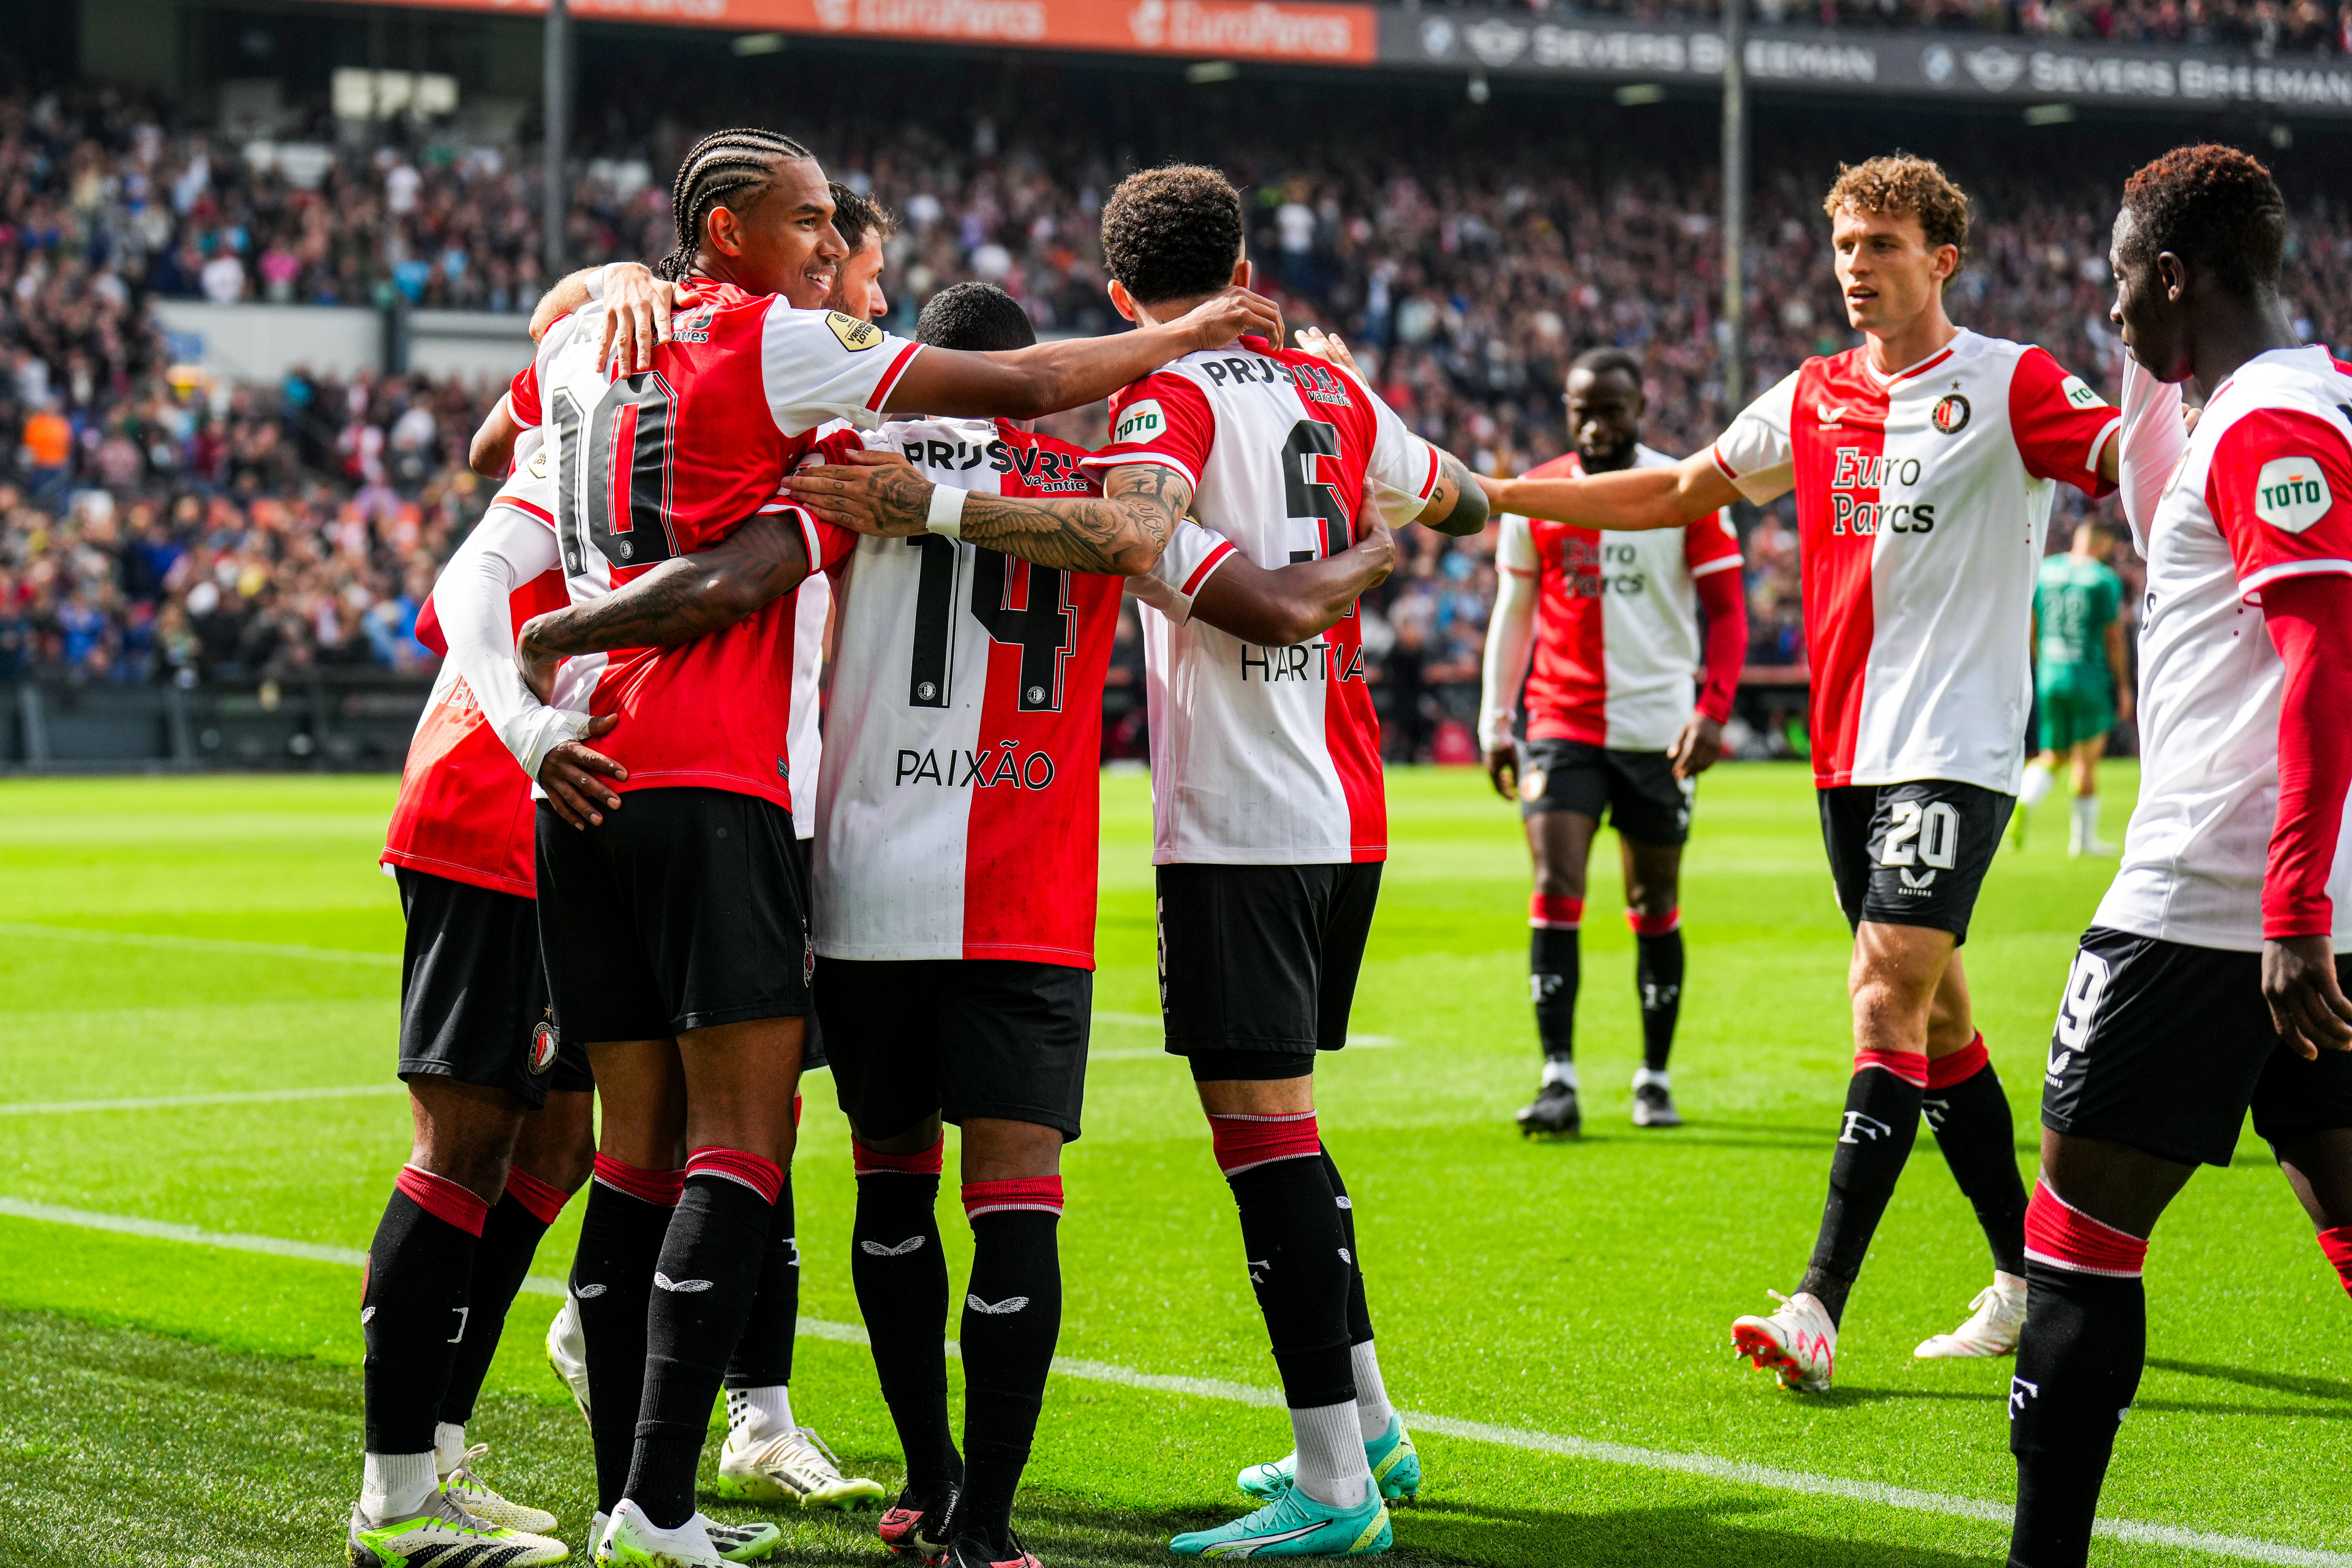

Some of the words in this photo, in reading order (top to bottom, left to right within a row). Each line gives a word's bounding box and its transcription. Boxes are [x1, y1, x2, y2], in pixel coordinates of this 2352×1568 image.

[1117, 413, 1158, 442] TOTO
[552, 370, 681, 579] 10
[1831, 447, 1921, 489] Euro
[1281, 419, 1354, 617] 5
[1831, 492, 1935, 536] Parcs
[2261, 480, 2321, 510] TOTO
[905, 534, 1077, 712] 14
[894, 740, 1055, 790] PAIXÃO
[1880, 800, 1960, 870] 20
